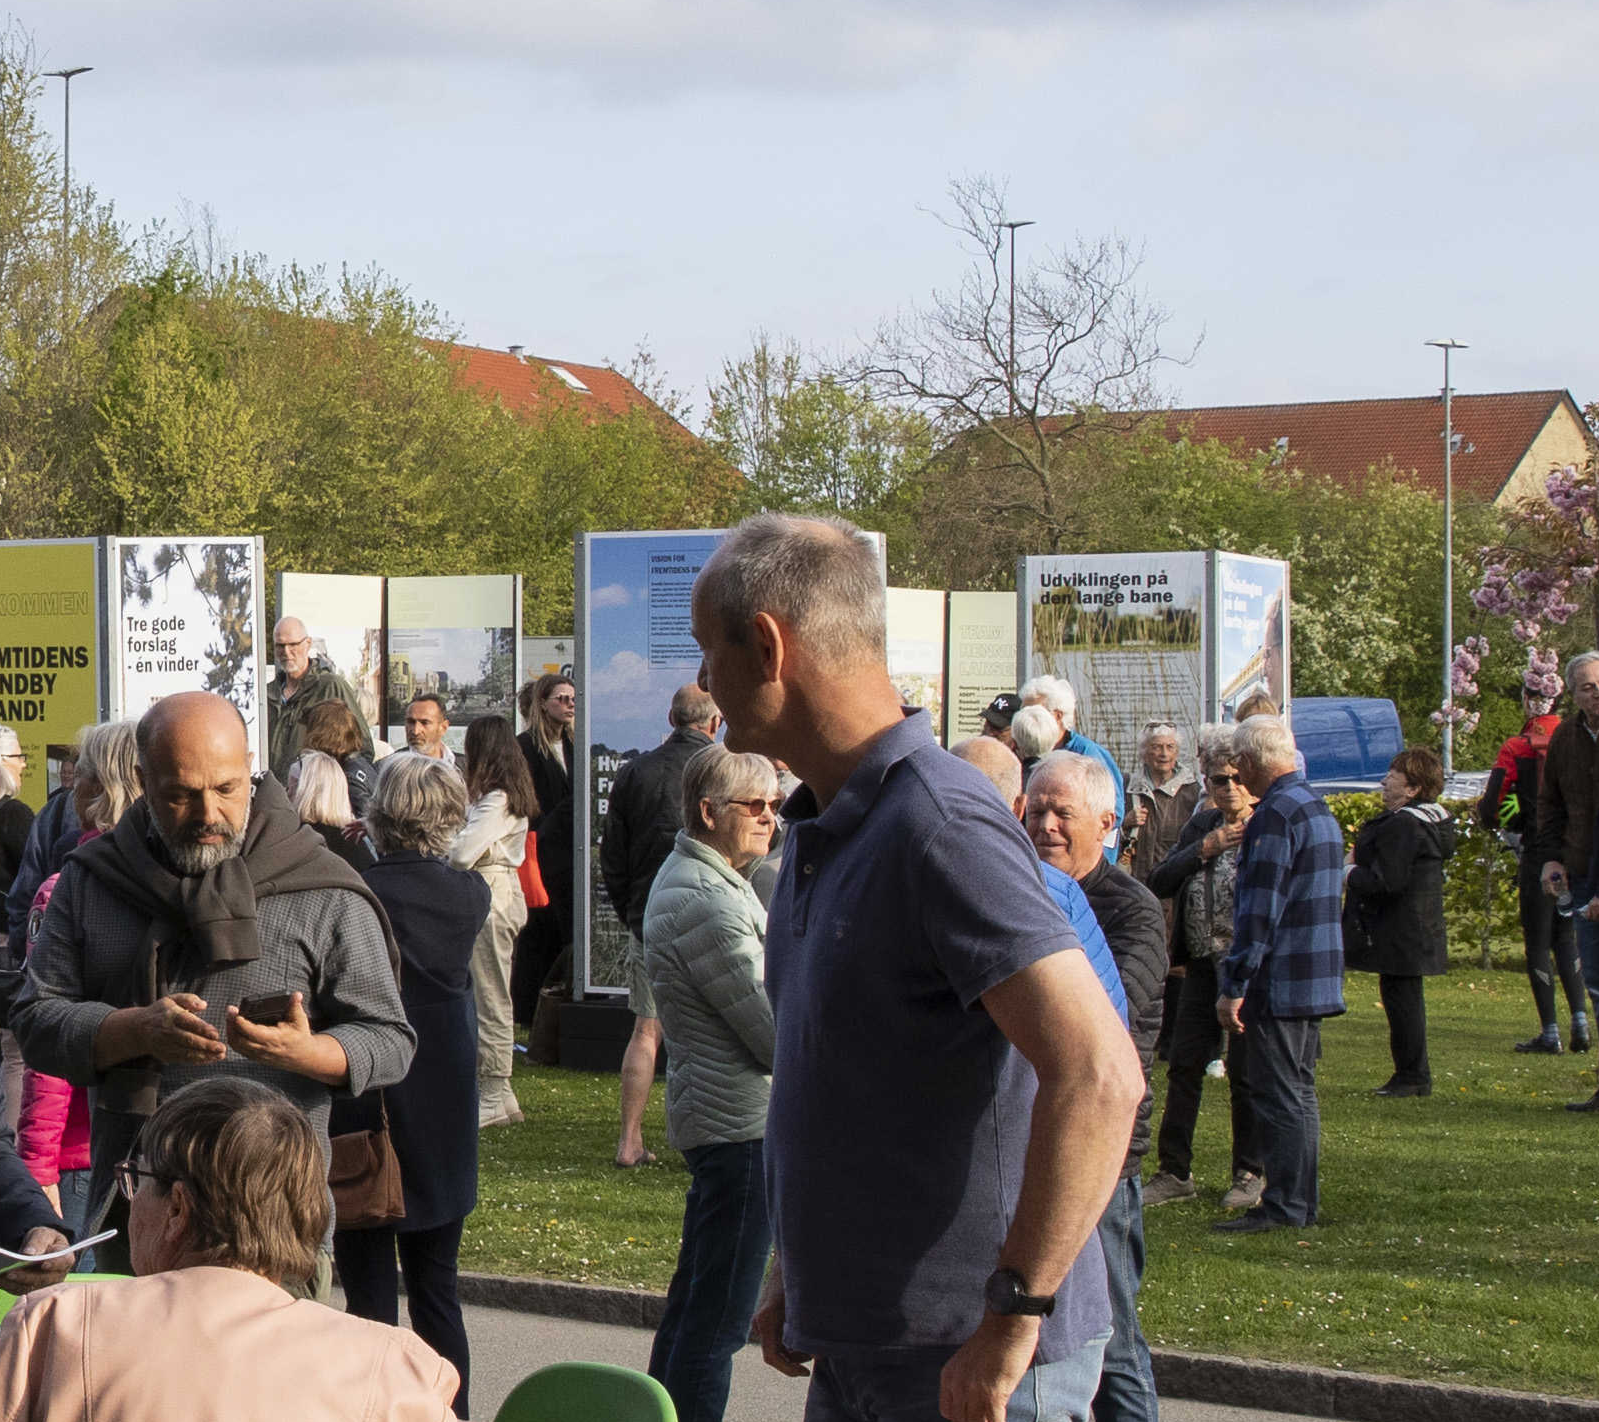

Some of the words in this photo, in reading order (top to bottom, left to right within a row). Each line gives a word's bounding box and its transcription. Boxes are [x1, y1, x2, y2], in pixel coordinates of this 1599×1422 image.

[1040, 573, 1141, 590] Udviklingen
[1147, 569, 1168, 588] på
[1040, 591, 1072, 605] den
[1077, 589, 1124, 607] lange
[1129, 589, 1174, 604] bane
[127, 616, 147, 633] Tre
[151, 615, 186, 635] gode
[127, 636, 177, 655] forslag
[136, 656, 152, 673] én
[156, 656, 199, 673] vinder
